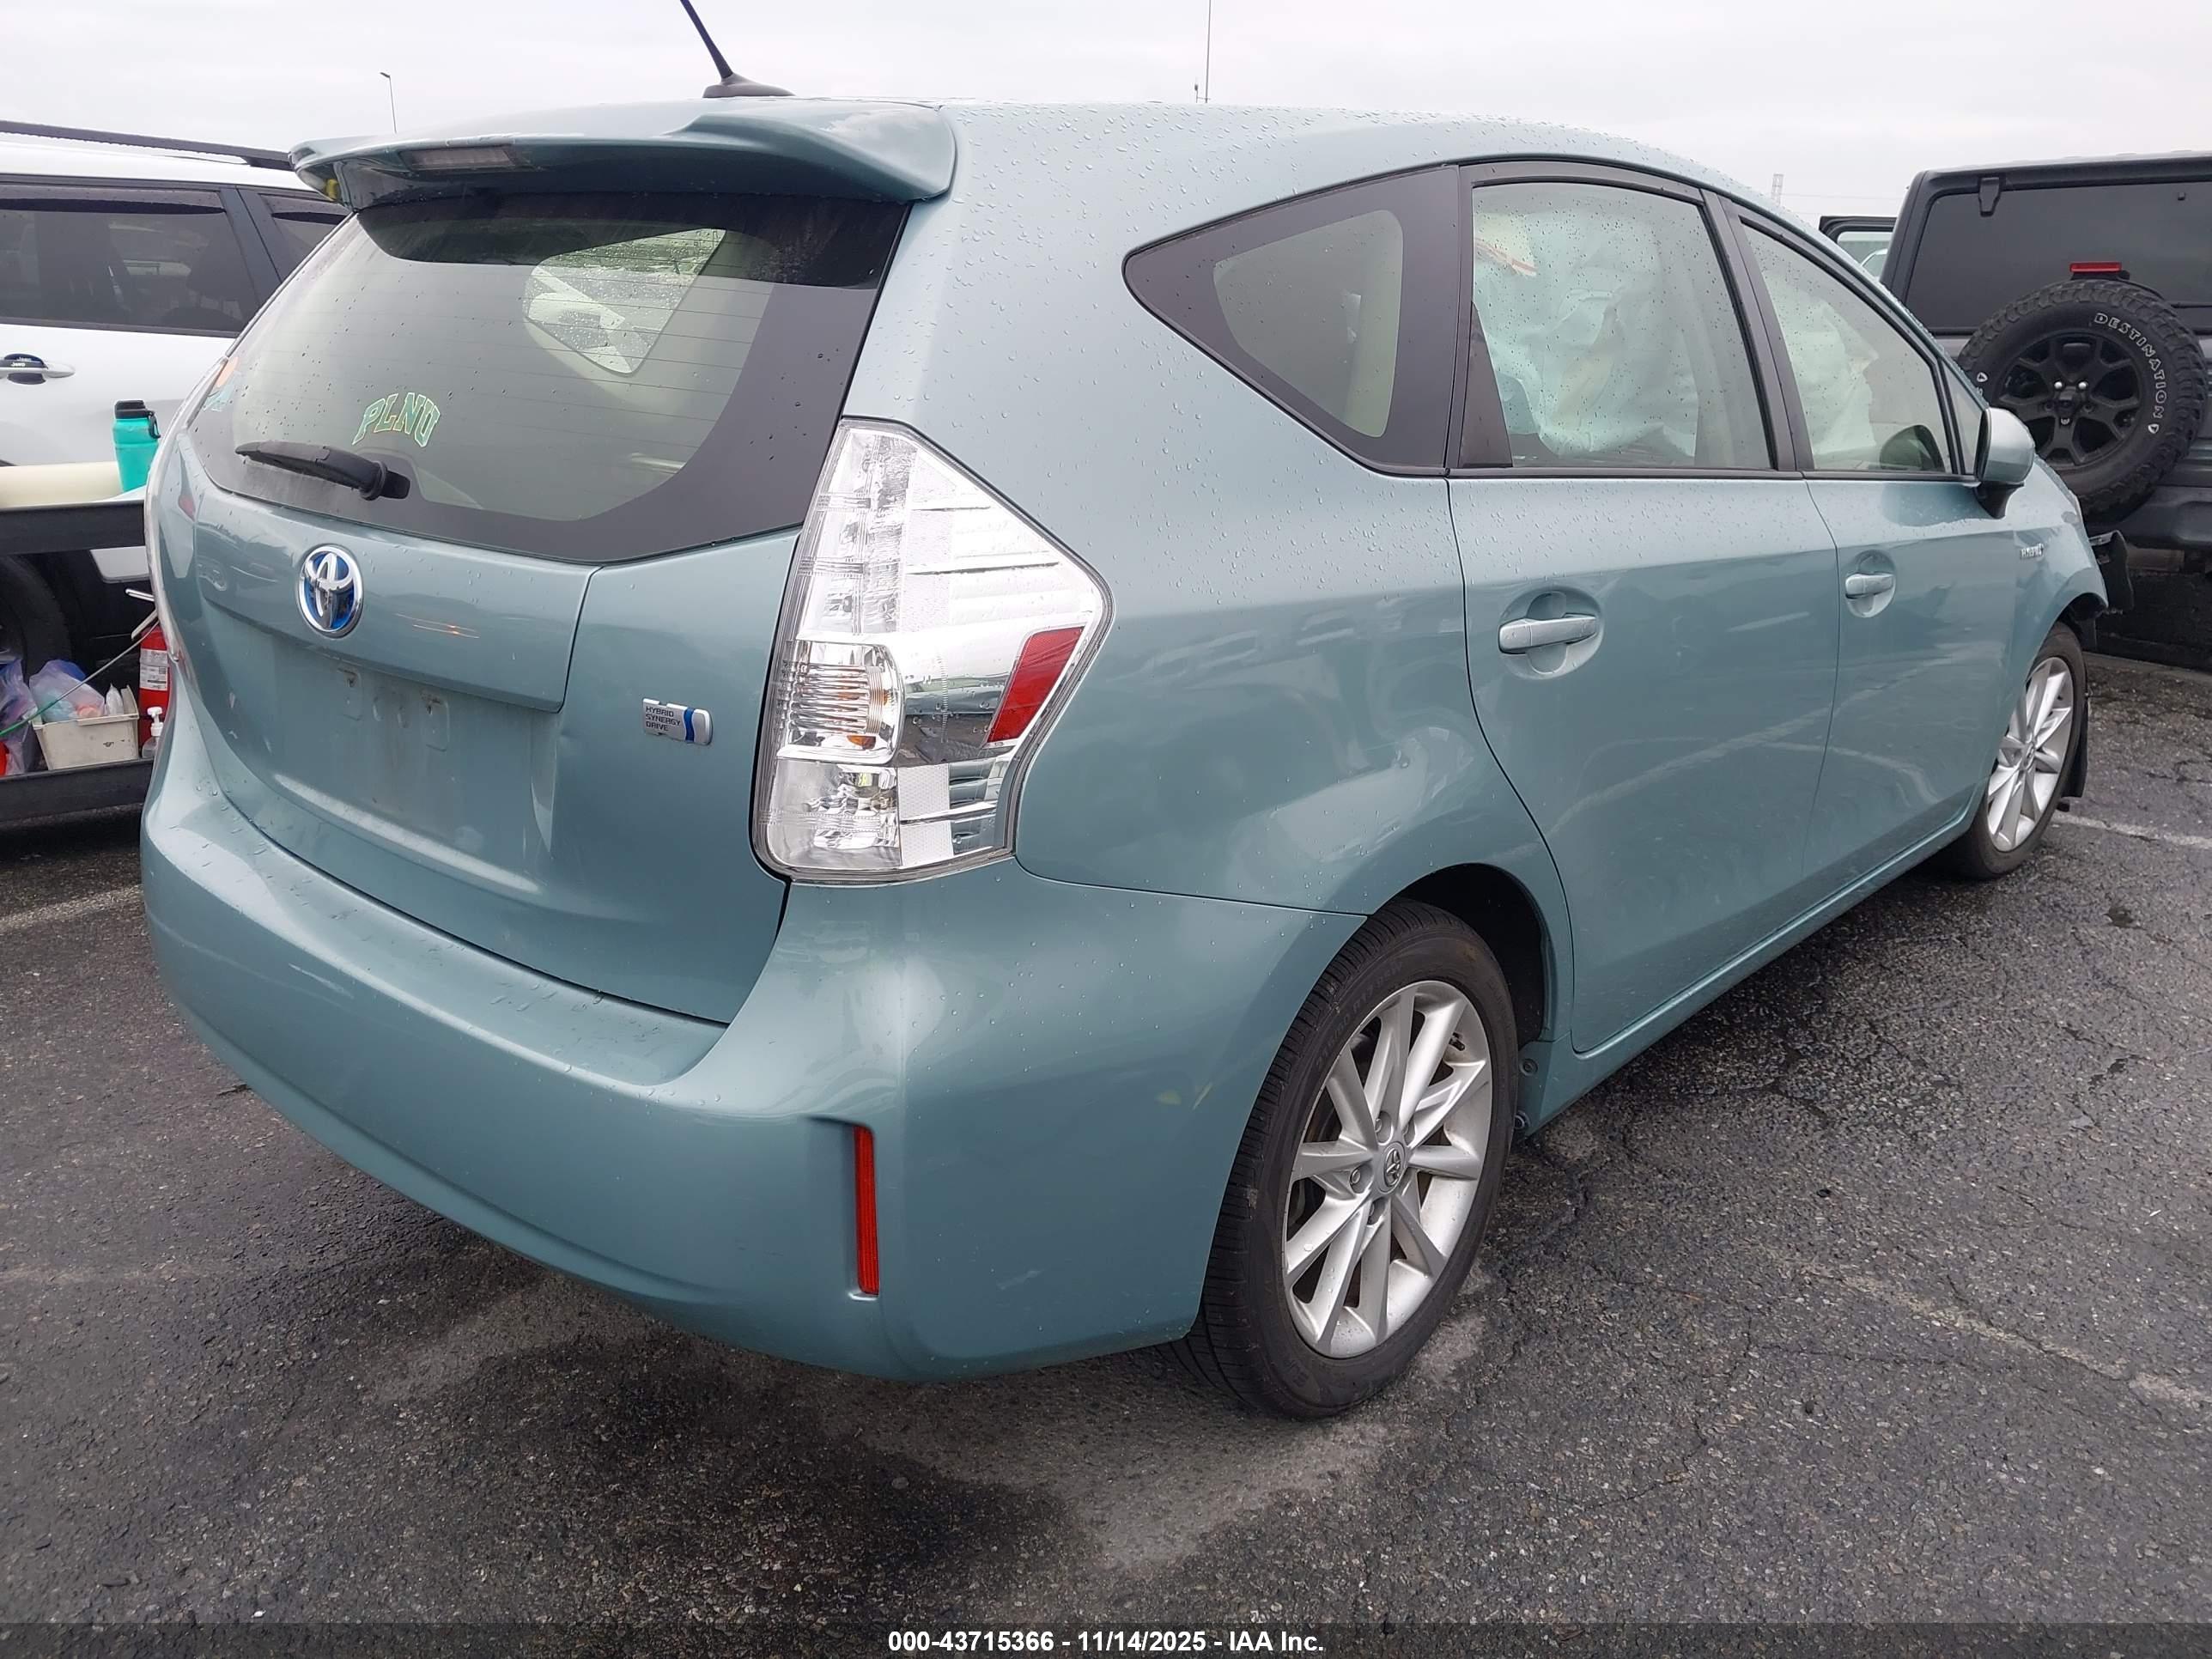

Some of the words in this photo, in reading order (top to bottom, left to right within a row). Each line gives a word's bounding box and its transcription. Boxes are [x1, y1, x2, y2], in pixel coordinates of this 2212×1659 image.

[2094, 313, 2167, 419] DESTINATION
[352, 392, 441, 447] PLNU
[646, 706, 674, 718] HYBRID
[645, 714, 681, 726] SYNERGY
[646, 720, 669, 732] DRIVE
